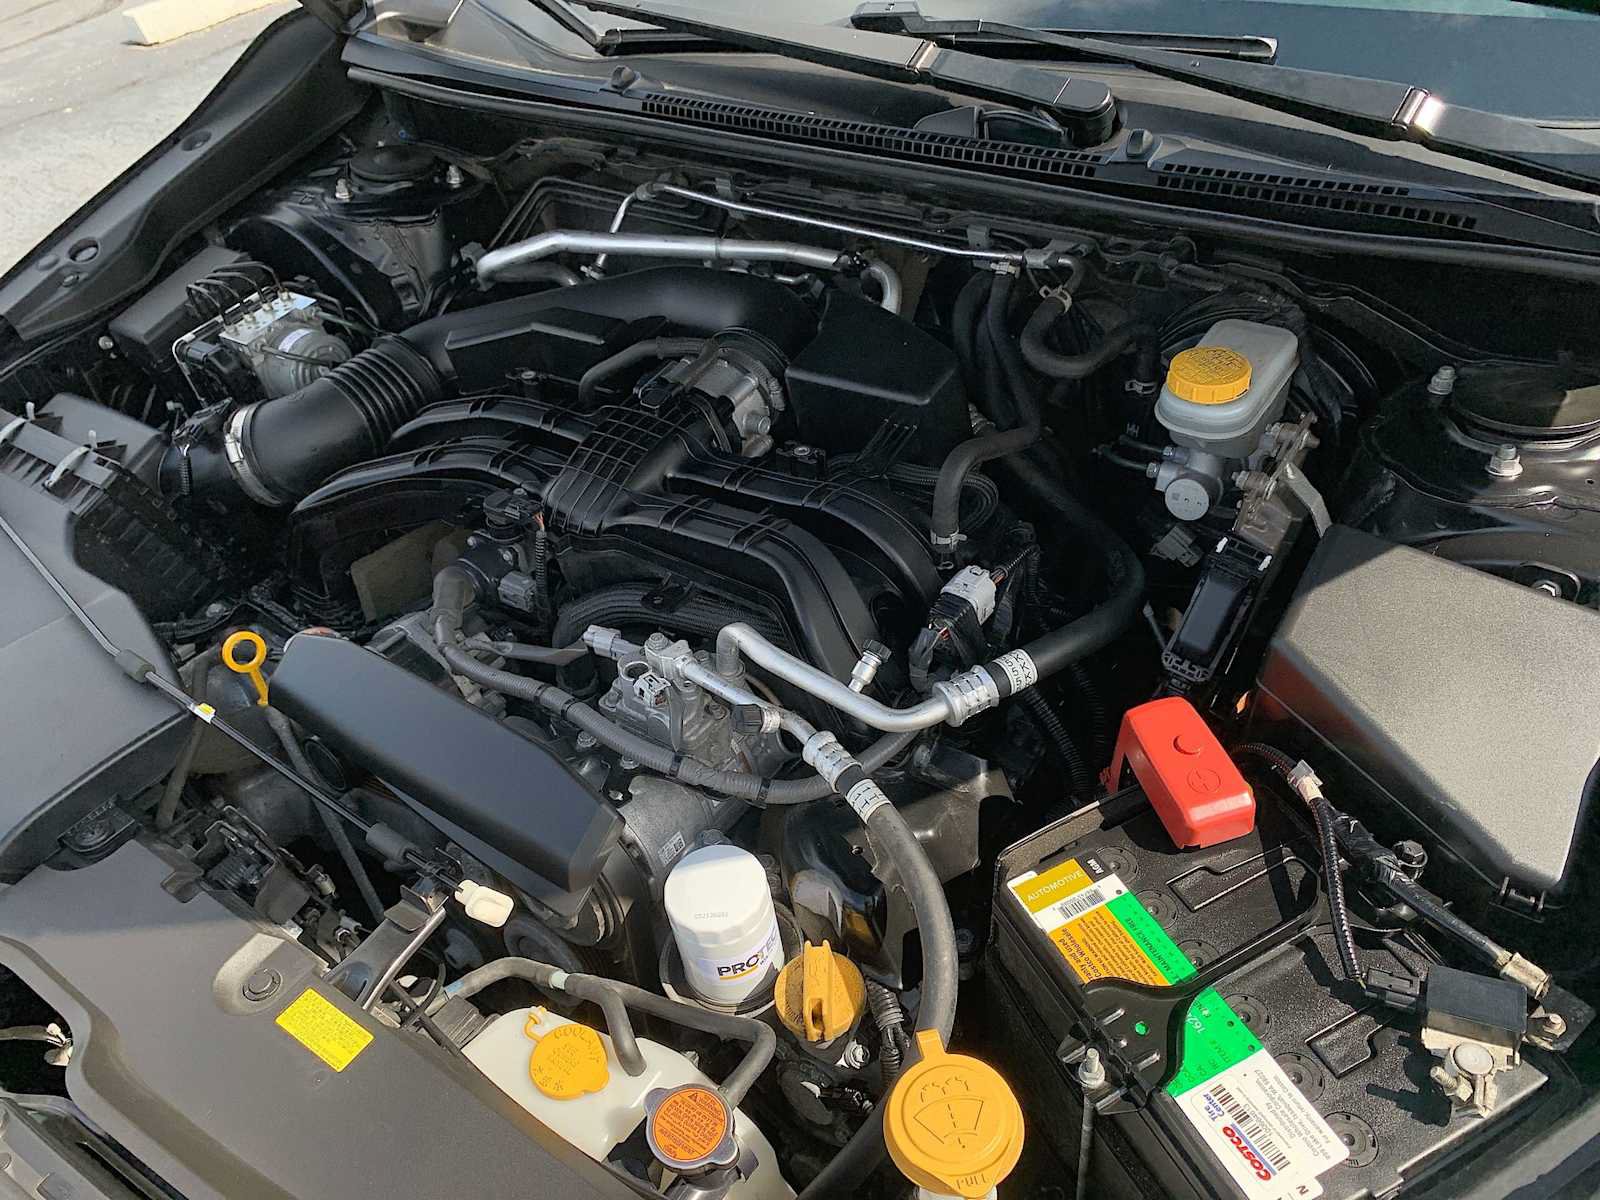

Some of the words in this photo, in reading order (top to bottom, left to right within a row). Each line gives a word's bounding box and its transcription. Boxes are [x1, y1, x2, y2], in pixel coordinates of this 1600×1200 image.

[1087, 858, 1104, 874] AGM
[1027, 870, 1083, 901] AUTOMOTIVE
[1060, 927, 1086, 957] Wholesale
[1082, 956, 1101, 977] Costco
[1202, 1092, 1224, 1117] Center
[1204, 1105, 1217, 1121] Tire
[1222, 1126, 1272, 1181] COSTCO
